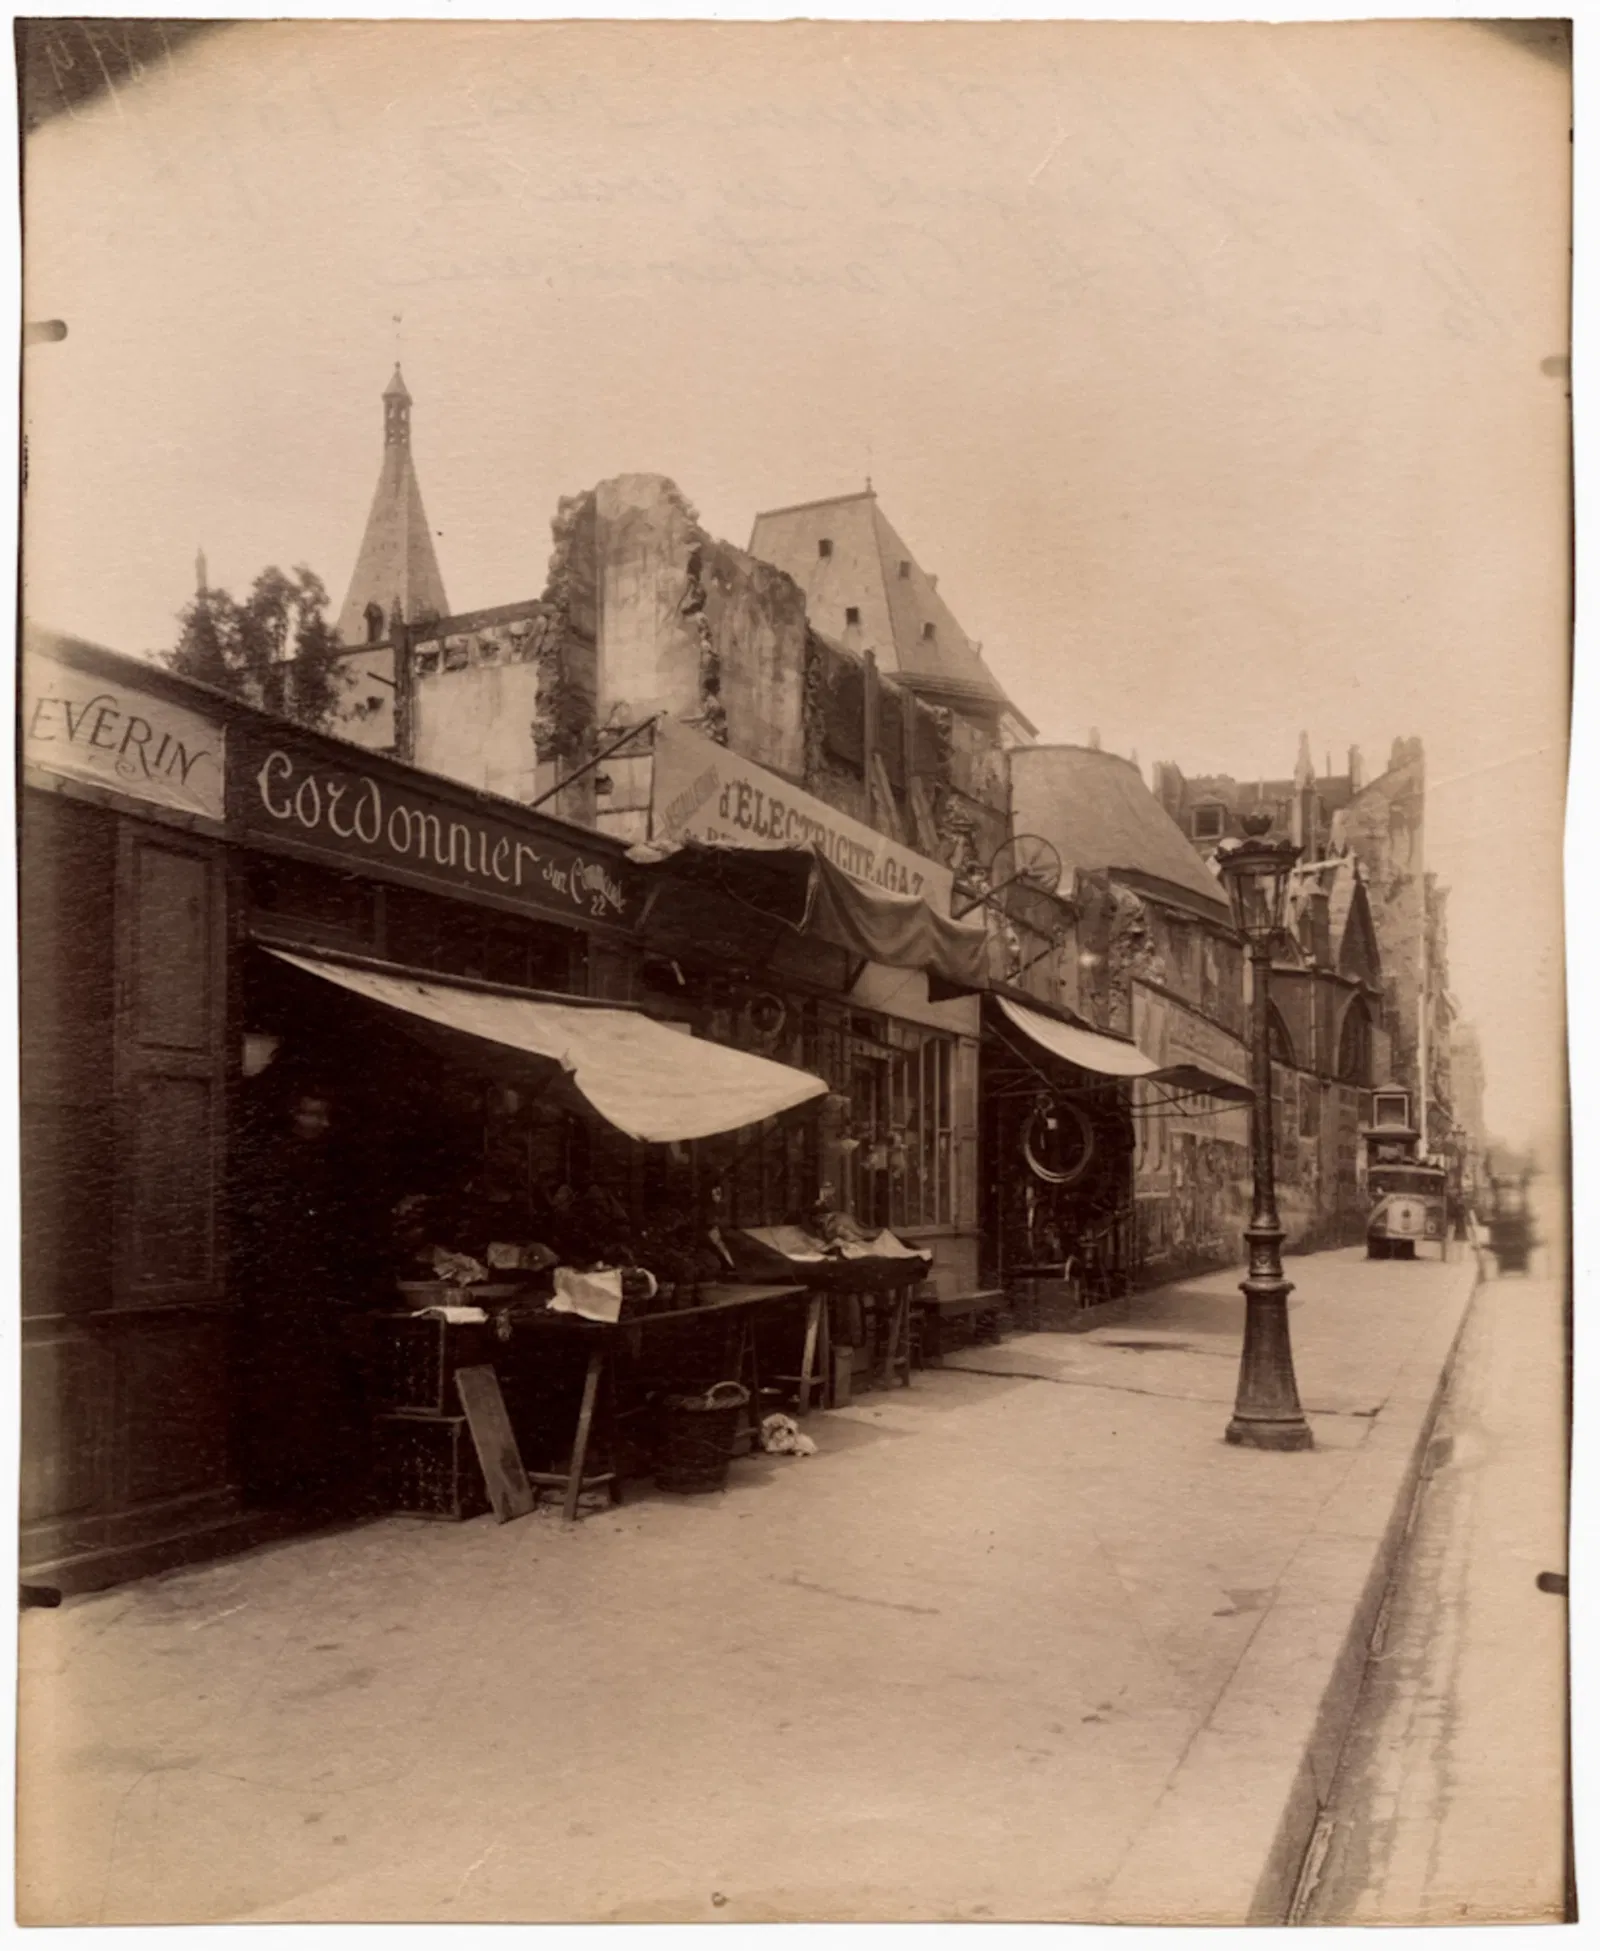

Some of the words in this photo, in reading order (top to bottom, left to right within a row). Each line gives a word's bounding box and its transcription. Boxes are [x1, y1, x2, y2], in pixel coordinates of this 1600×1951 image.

[29, 694, 212, 787] EVERIN
[257, 751, 541, 886] Cordonnier
[590, 894, 607, 916] 22
